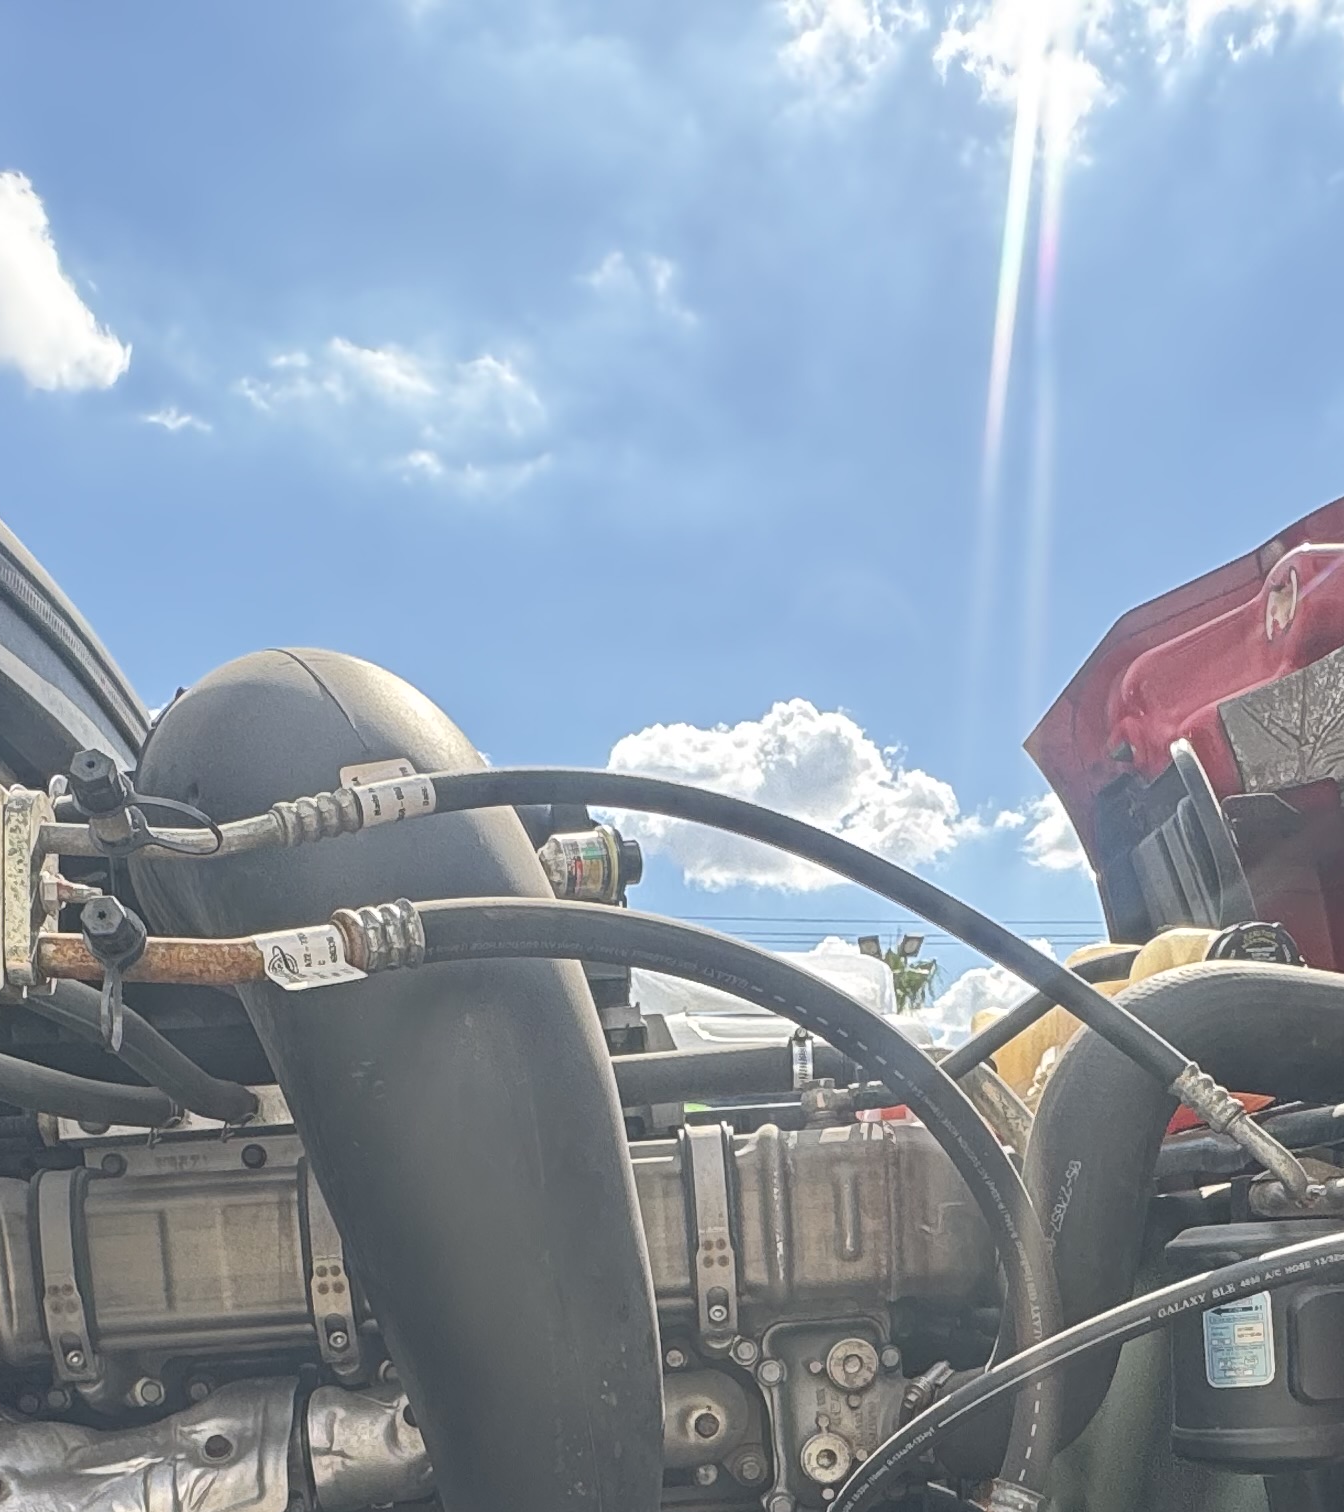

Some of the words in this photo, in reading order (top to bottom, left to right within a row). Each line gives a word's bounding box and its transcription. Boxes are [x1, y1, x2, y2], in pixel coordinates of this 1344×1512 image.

[1157, 1292, 1208, 1318] GALAXY
[1211, 1283, 1236, 1298] SLE
[1264, 1268, 1281, 1280] A/C
[1284, 1260, 1311, 1274] HOSE
[1030, 1301, 1043, 1340] ALAXY
